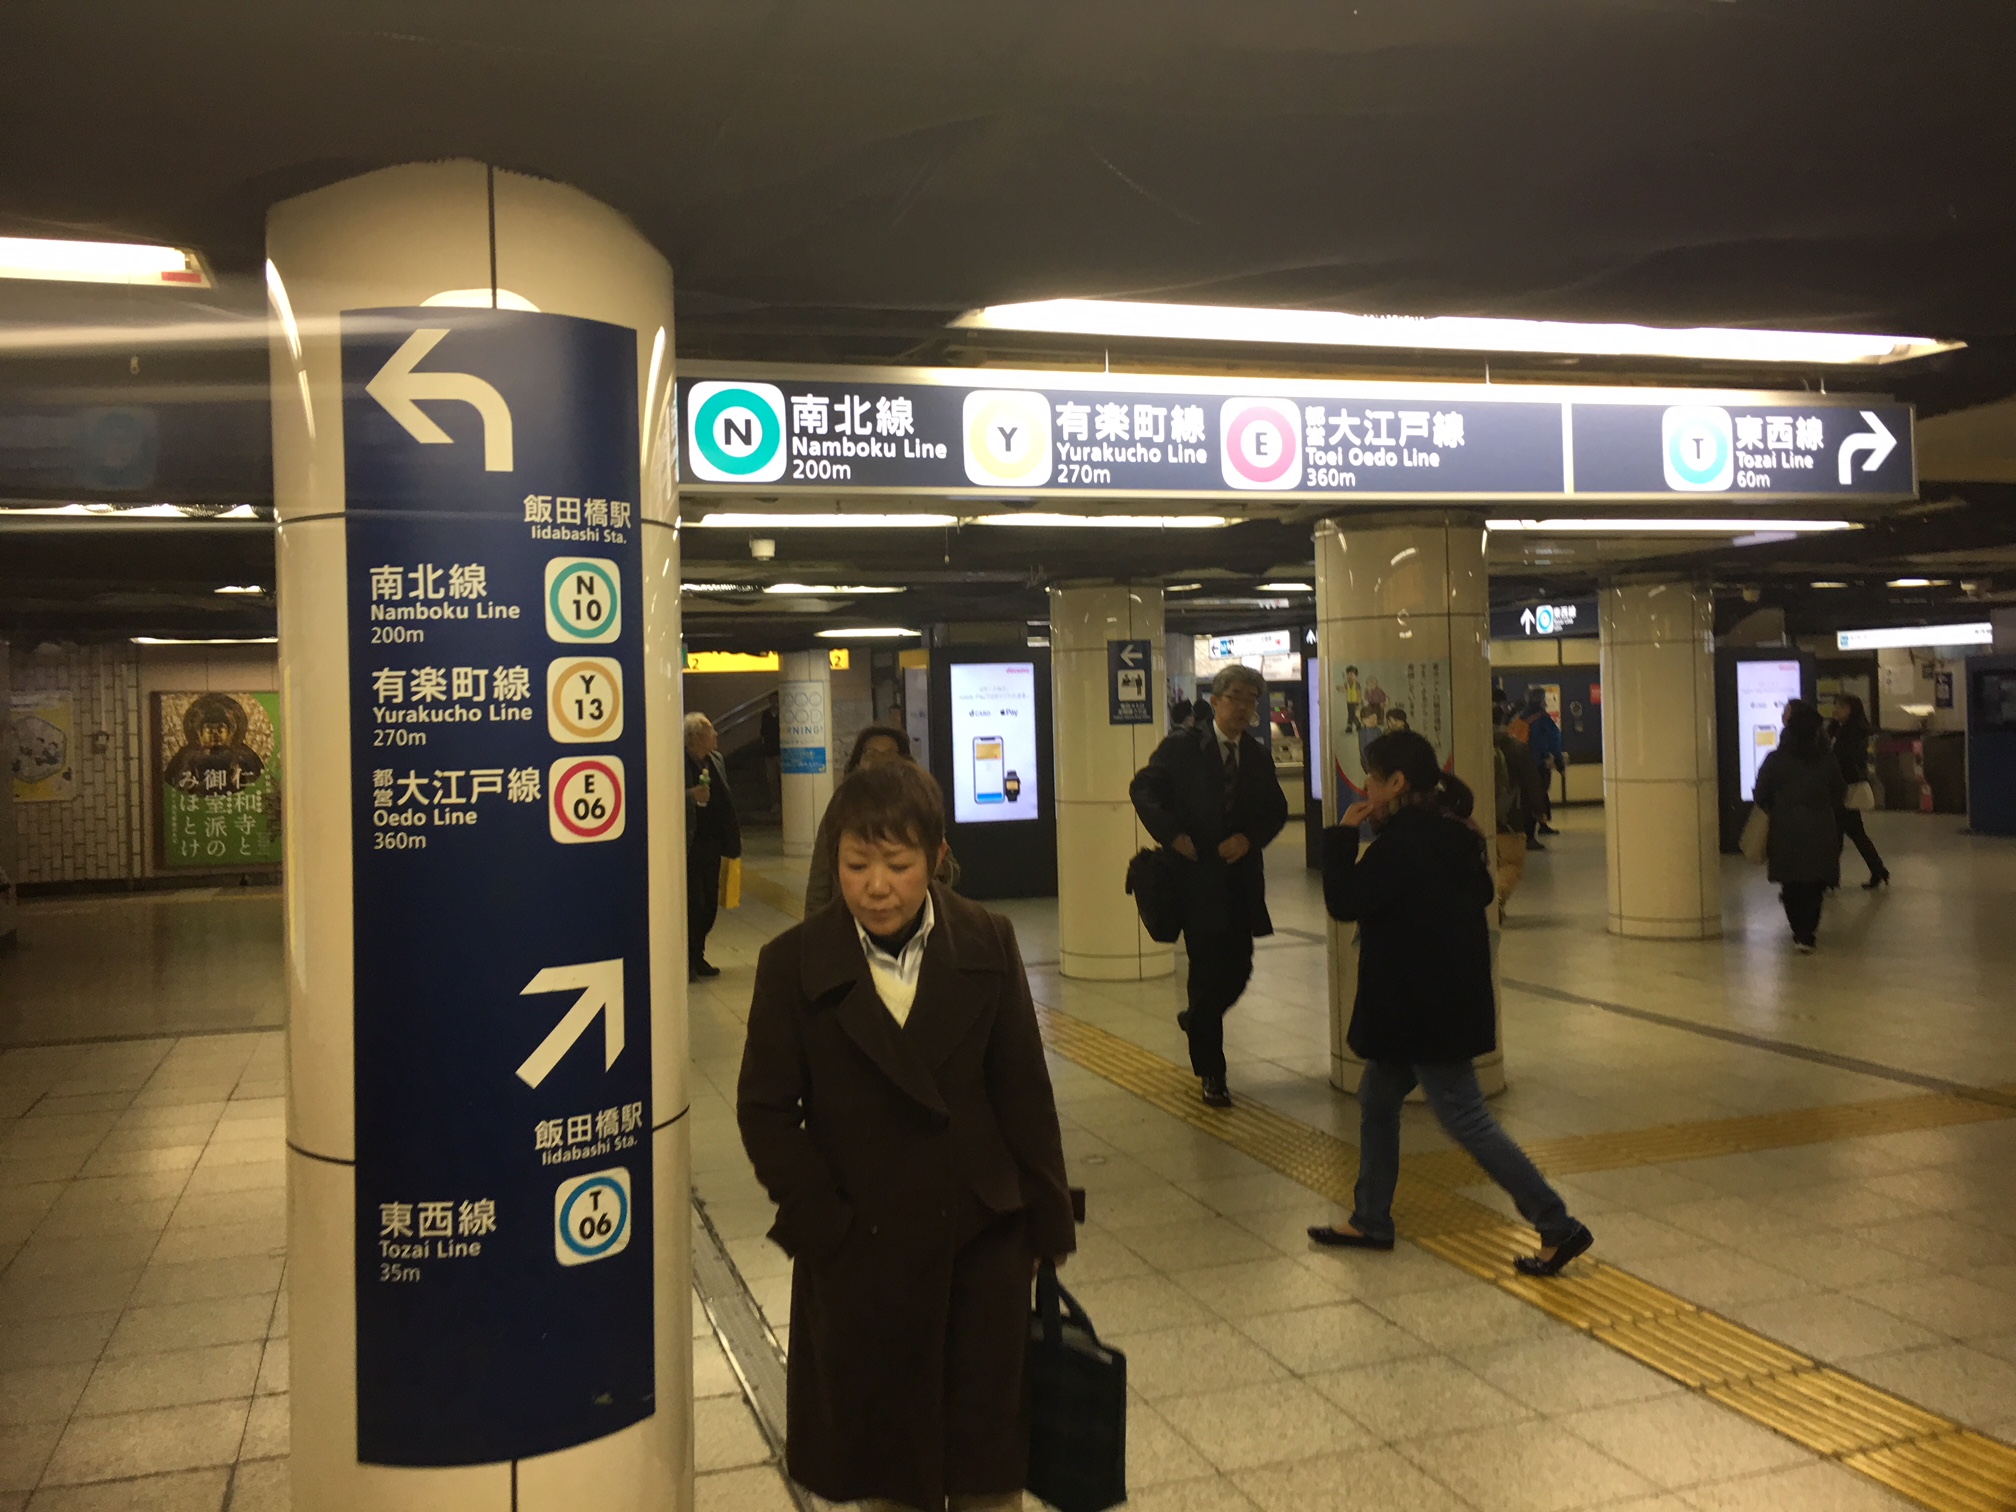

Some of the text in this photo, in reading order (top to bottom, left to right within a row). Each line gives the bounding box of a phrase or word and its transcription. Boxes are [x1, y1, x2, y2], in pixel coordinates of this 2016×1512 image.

[791, 394, 915, 437] 南北線
[1055, 401, 1206, 443] 有楽町線
[724, 418, 752, 446] N
[997, 426, 1019, 452] Y
[1328, 409, 1466, 449] 大江戸線
[1734, 414, 1825, 451] 東西線
[792, 436, 948, 460] Namboku Line
[1056, 443, 1208, 465] Yurakucho Line
[1255, 432, 1268, 457] E
[1692, 438, 1705, 460] T
[1305, 447, 1440, 468] Toei Oedo Line
[1736, 450, 1815, 470] Tozai Line
[793, 460, 852, 480] 200m
[1057, 465, 1111, 484] 270m
[1307, 468, 1356, 488] 360m
[1737, 470, 1771, 489] 60m
[523, 494, 632, 529] 飯田橋駅
[531, 525, 627, 544] Iidabashi Sta.
[370, 563, 487, 600] 南北線
[576, 575, 594, 595] N
[370, 601, 521, 621] Namboku Line
[572, 599, 602, 622] 10
[370, 627, 425, 644] 200m
[372, 665, 531, 704] 有楽町線
[580, 675, 595, 695] Y
[373, 704, 533, 724] Yurakucho Line
[574, 698, 604, 721] 13
[373, 730, 427, 747] 270m
[396, 767, 541, 806] 大江戸線
[584, 774, 596, 794] E
[179, 770, 199, 857] みほとけ
[373, 808, 478, 827] Oedo Line
[573, 797, 606, 820] 06
[373, 832, 427, 850] 360m
[534, 1101, 643, 1151] 飯田橋駅
[542, 1134, 638, 1166] Iidabashi Sta.
[589, 1191, 602, 1211] T
[379, 1198, 497, 1238] 東西線
[579, 1215, 612, 1240] 06
[379, 1239, 482, 1260] Tozai Line
[379, 1264, 421, 1283] 35m
